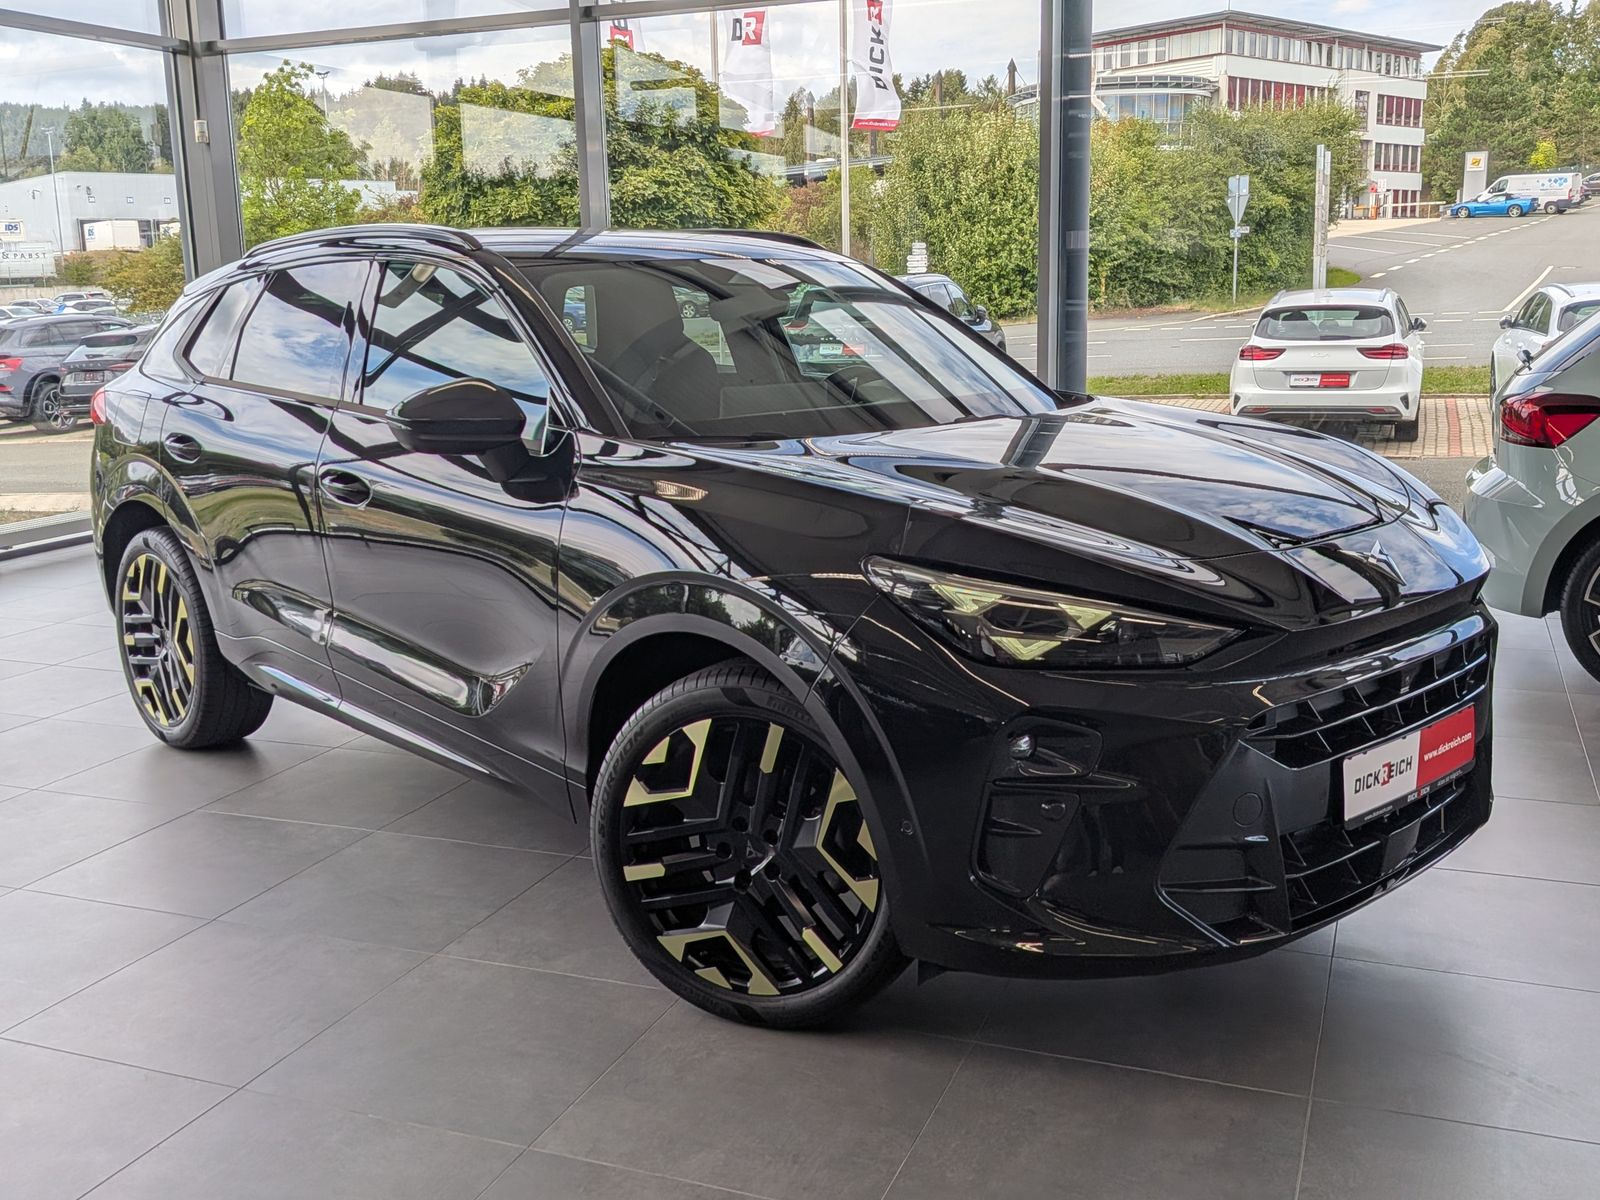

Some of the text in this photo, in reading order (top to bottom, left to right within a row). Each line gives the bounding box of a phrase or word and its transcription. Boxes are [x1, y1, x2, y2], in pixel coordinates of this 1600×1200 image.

[731, 14, 760, 42] DR
[867, 0, 889, 91] DICKR
[13, 252, 47, 260] PABST
[1354, 755, 1412, 794] DICKREICH
[1423, 732, 1472, 760] www.dickreich.com
